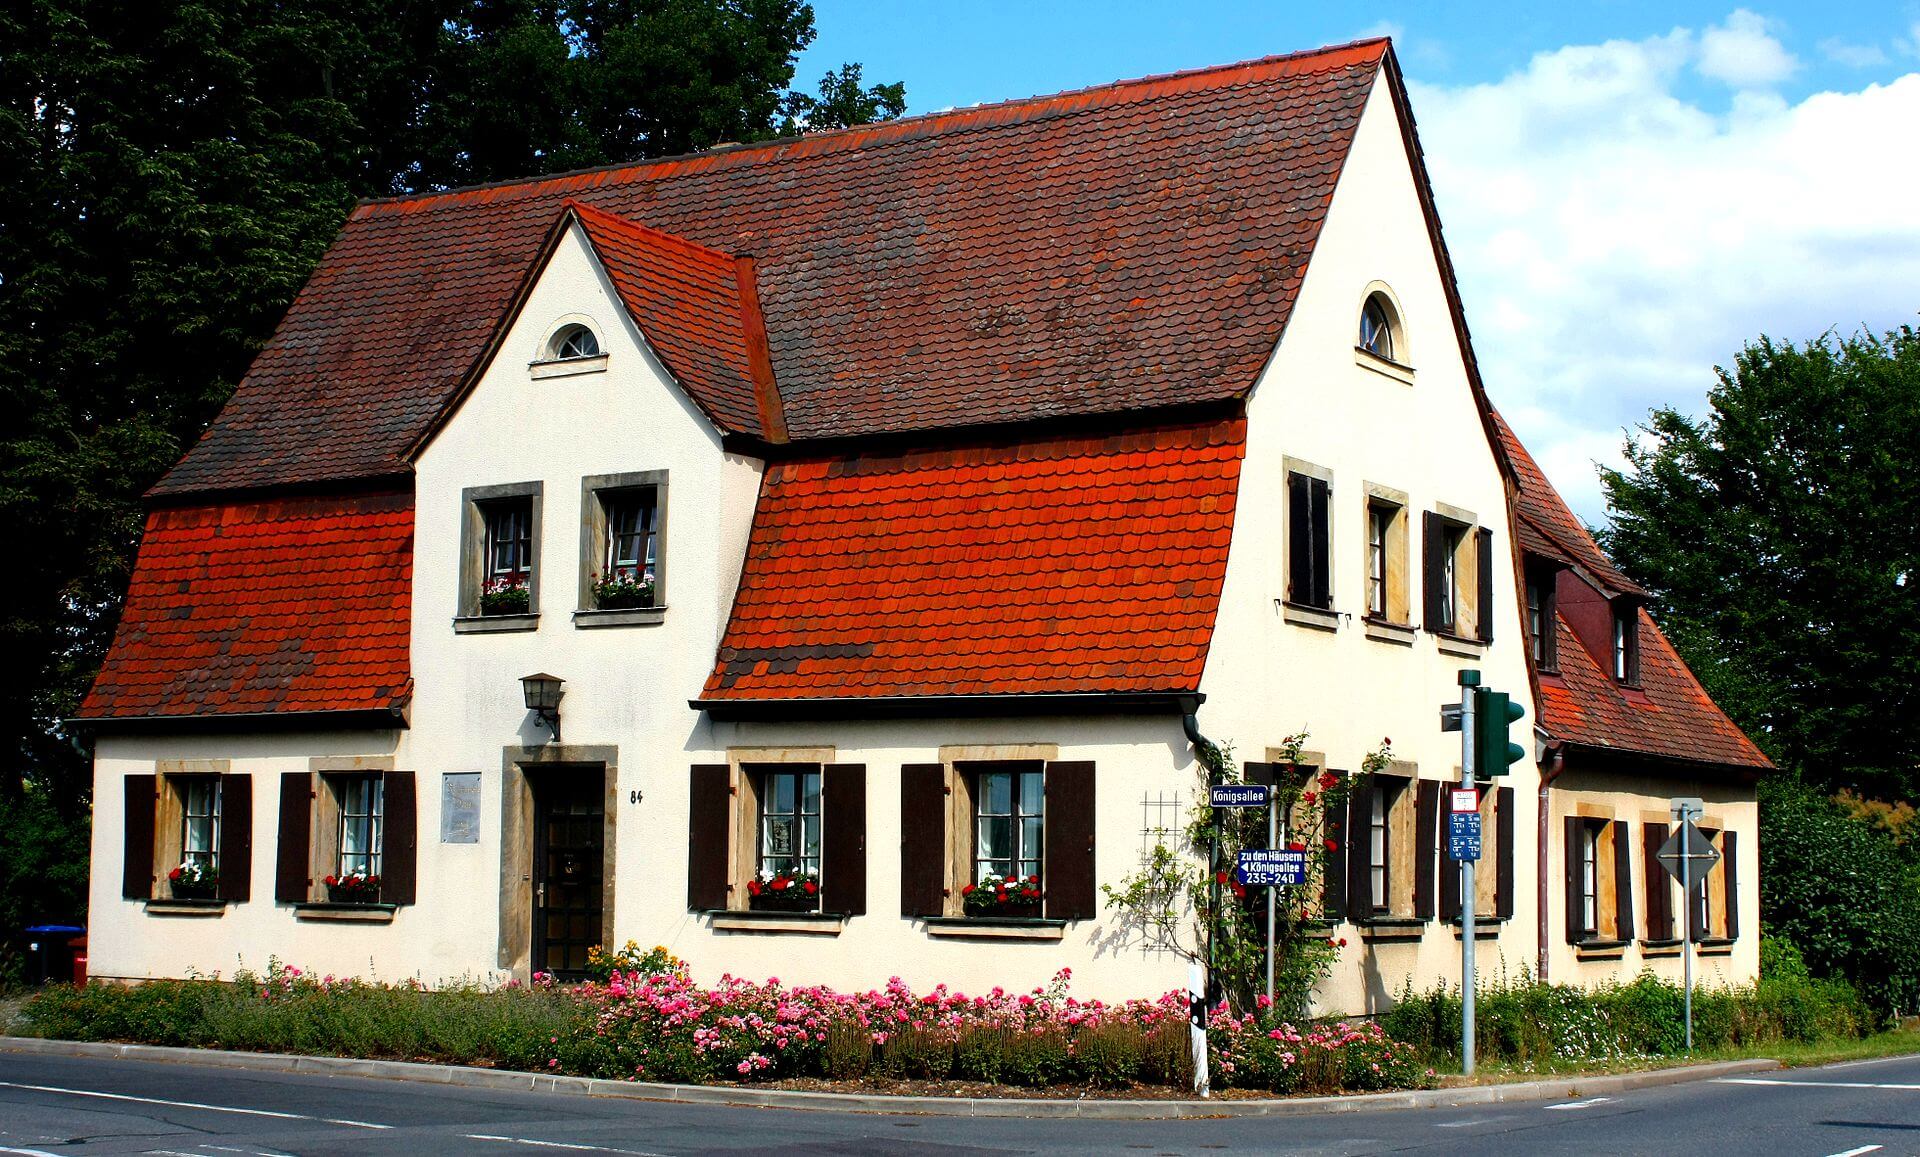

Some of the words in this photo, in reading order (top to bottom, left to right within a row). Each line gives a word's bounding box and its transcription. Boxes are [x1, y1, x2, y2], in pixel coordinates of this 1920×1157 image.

[630, 790, 643, 804] 84
[1213, 790, 1264, 804] Königsallee
[1241, 852, 1251, 861] zu
[1252, 850, 1267, 861] den
[1268, 850, 1302, 862] Häusern
[1250, 862, 1300, 874] Königsallee
